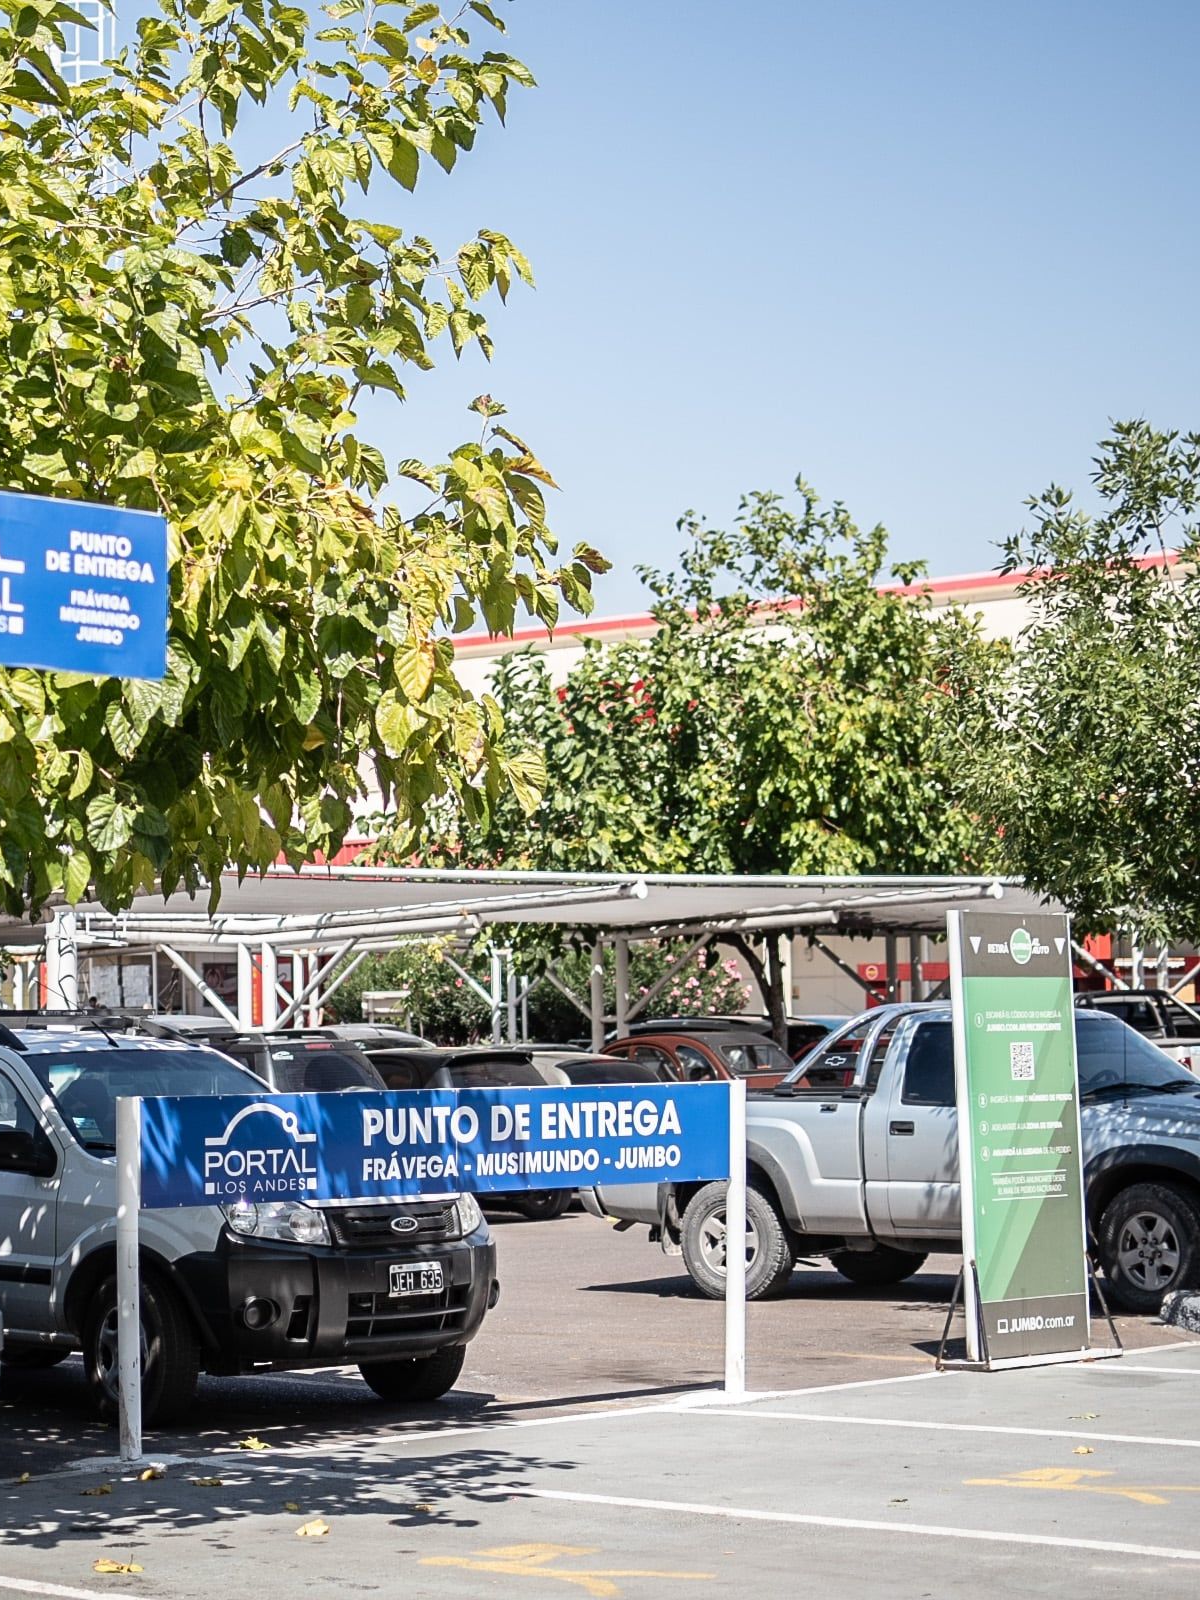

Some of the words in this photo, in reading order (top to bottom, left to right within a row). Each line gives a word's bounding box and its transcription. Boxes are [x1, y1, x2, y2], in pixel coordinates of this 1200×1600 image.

[69, 530, 132, 558] PUNTO
[45, 549, 70, 573] DE
[74, 553, 155, 584] ENTREGA
[362, 1105, 479, 1147] PUNTO
[491, 1104, 530, 1142] DE
[541, 1099, 682, 1140] ENTREGA
[205, 1149, 316, 1177] PORTAL
[362, 1151, 459, 1181] FRÁVEGA
[477, 1149, 600, 1177] MUSIMUNDO
[615, 1144, 681, 1170] JUMBO
[216, 1180, 247, 1195] LOS
[254, 1177, 306, 1192] ANDES
[393, 1273, 414, 1291] JEH
[420, 1270, 441, 1289] 635
[1010, 1315, 1075, 1333] JUMBO.com.ar
